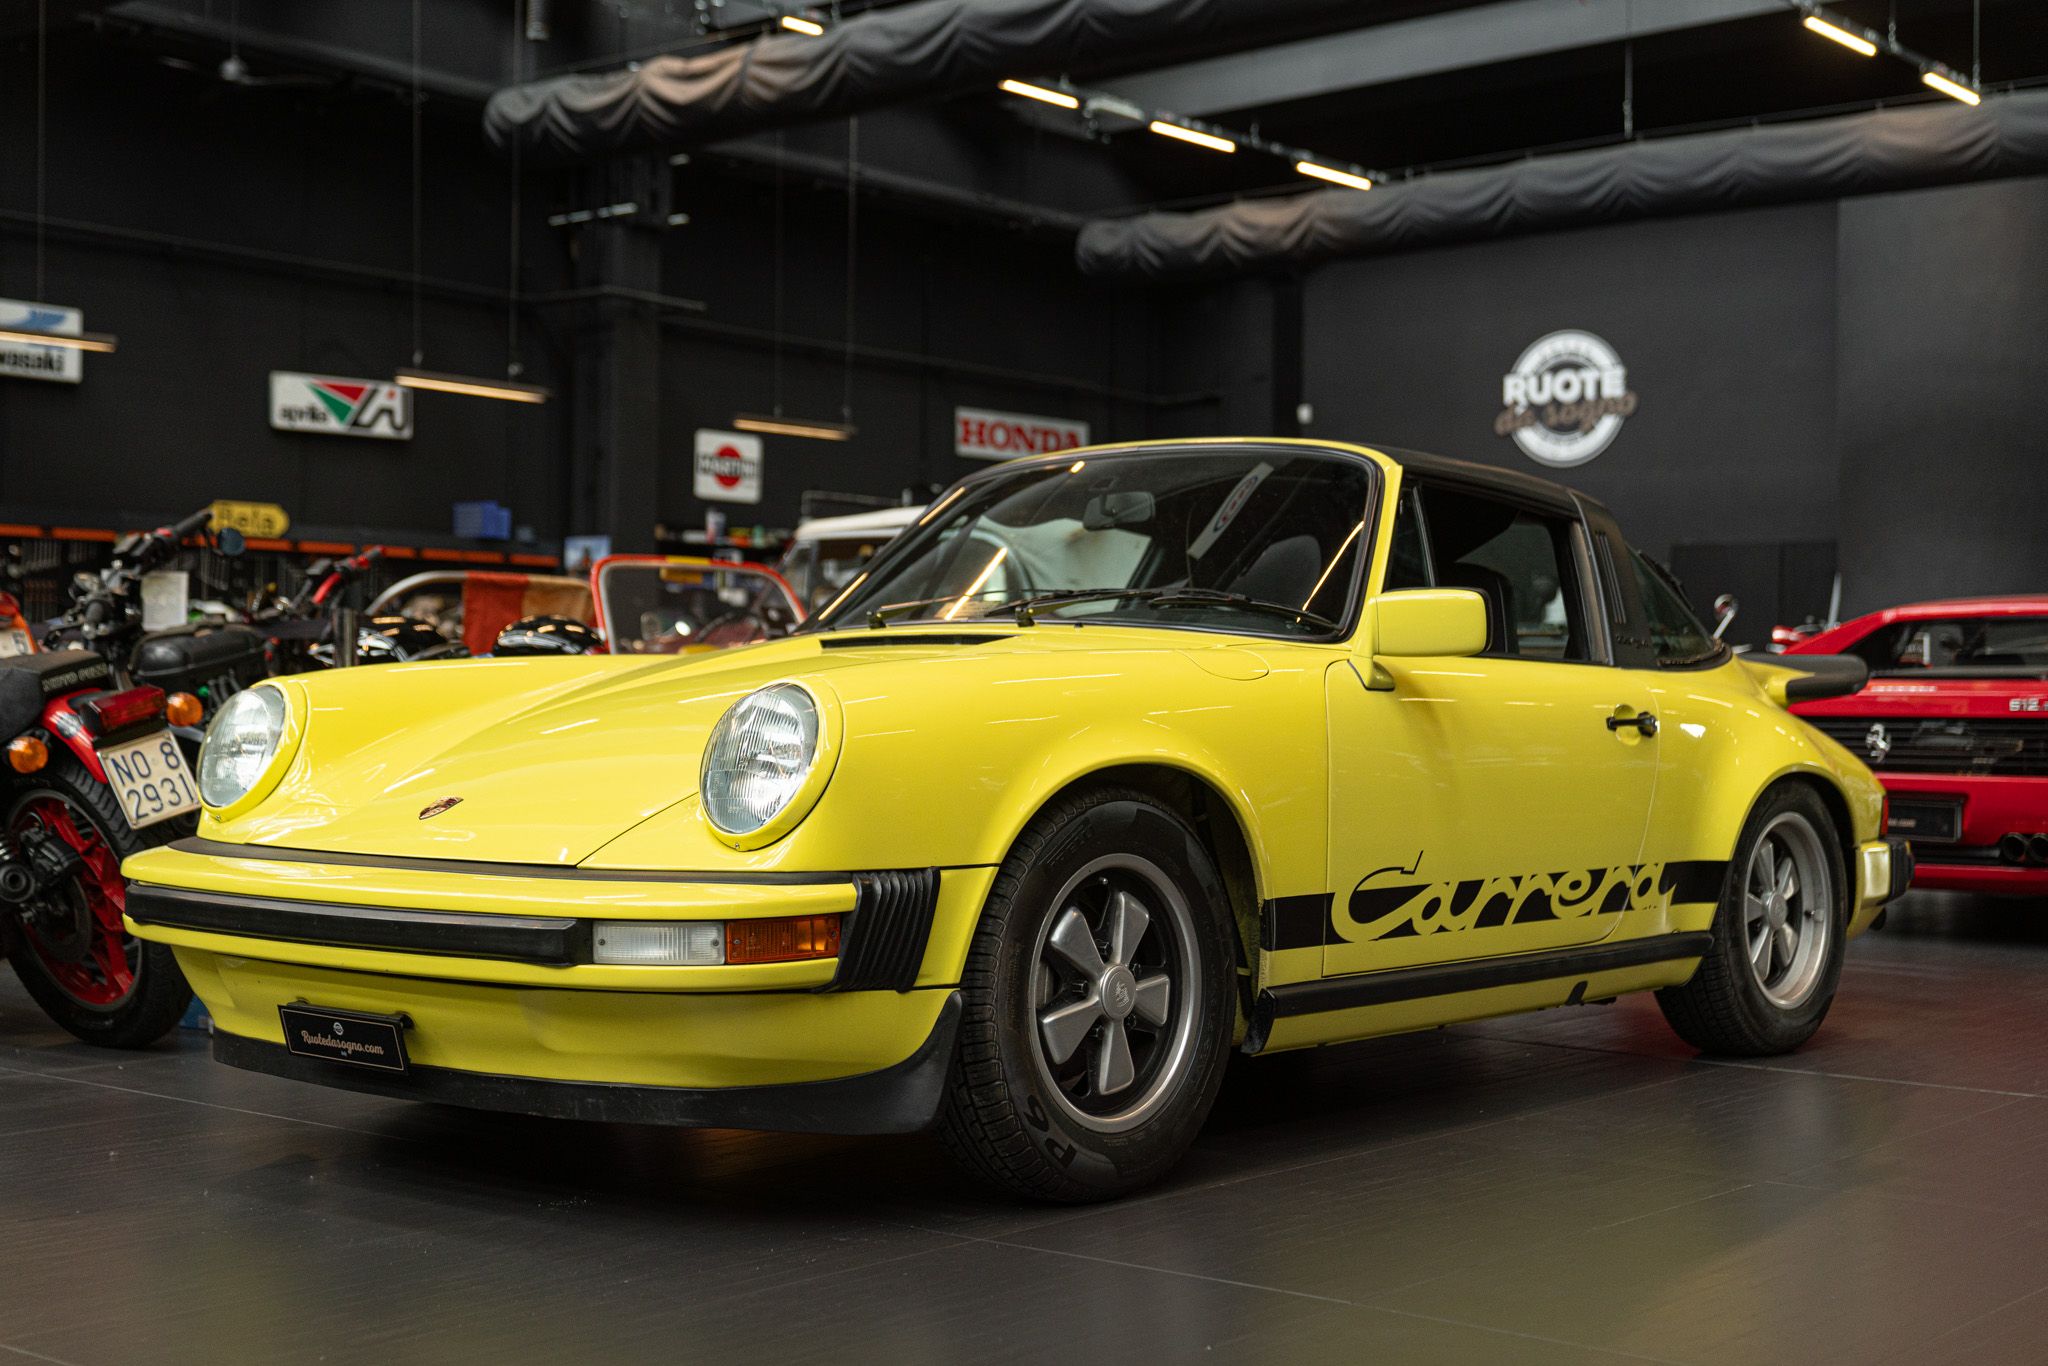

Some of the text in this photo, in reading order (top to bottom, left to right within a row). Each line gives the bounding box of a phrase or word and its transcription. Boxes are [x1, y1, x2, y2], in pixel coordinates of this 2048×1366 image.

[1503, 366, 1626, 414] RUOTE
[960, 417, 1081, 453] HONDA
[110, 742, 180, 787] NO 8
[126, 773, 194, 819] 2931
[1331, 850, 1677, 943] Carrera
[301, 1030, 384, 1056] Ruotedasogno.com
